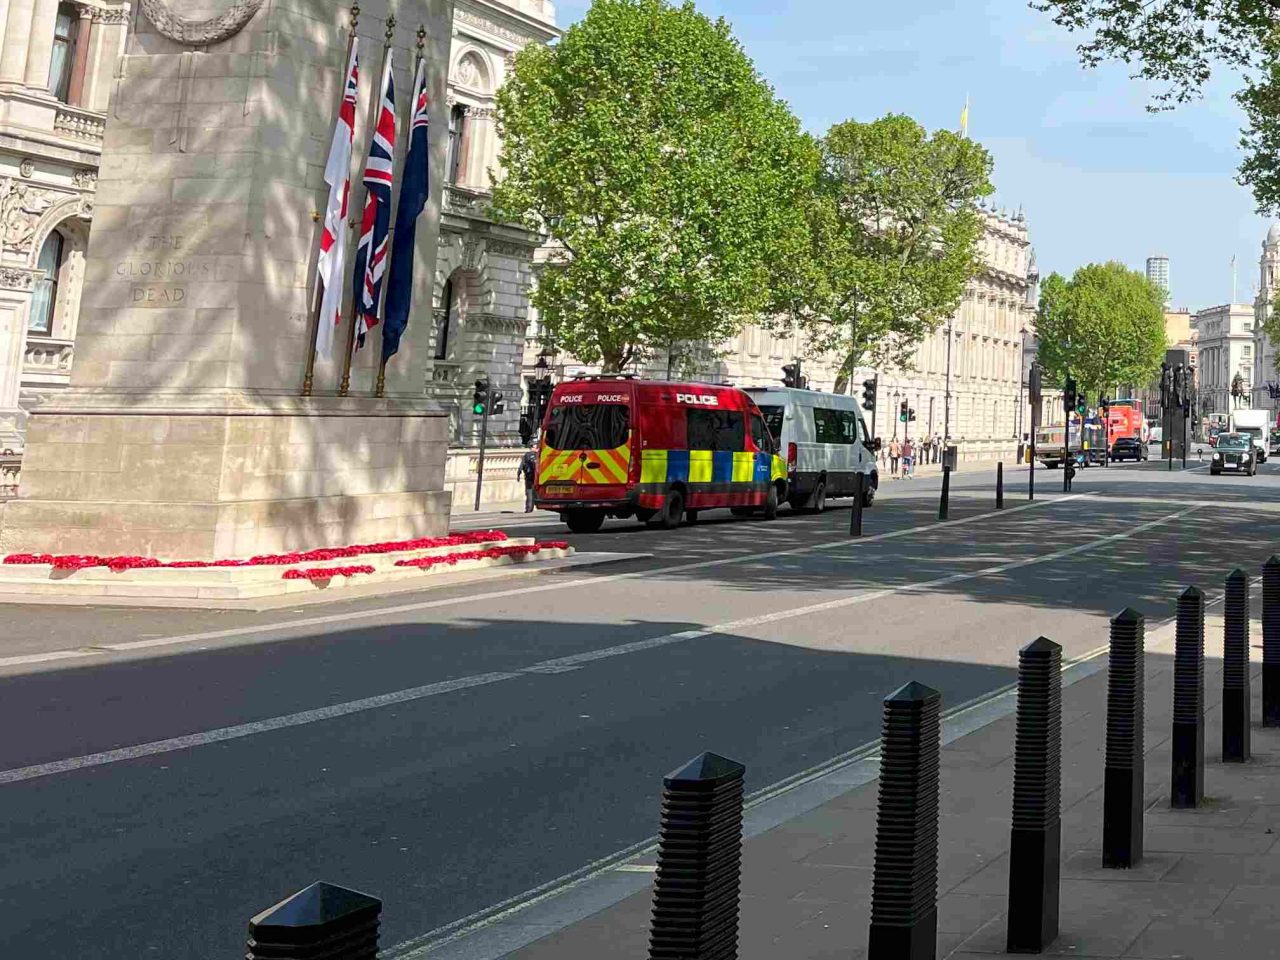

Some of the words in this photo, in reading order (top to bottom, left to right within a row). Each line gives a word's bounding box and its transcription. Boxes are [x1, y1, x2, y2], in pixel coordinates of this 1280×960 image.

[148, 235, 184, 250] THE
[132, 287, 186, 302] DEAD
[560, 394, 583, 403] POLICE
[597, 394, 622, 403] POLICE
[676, 393, 719, 406] POLICE
